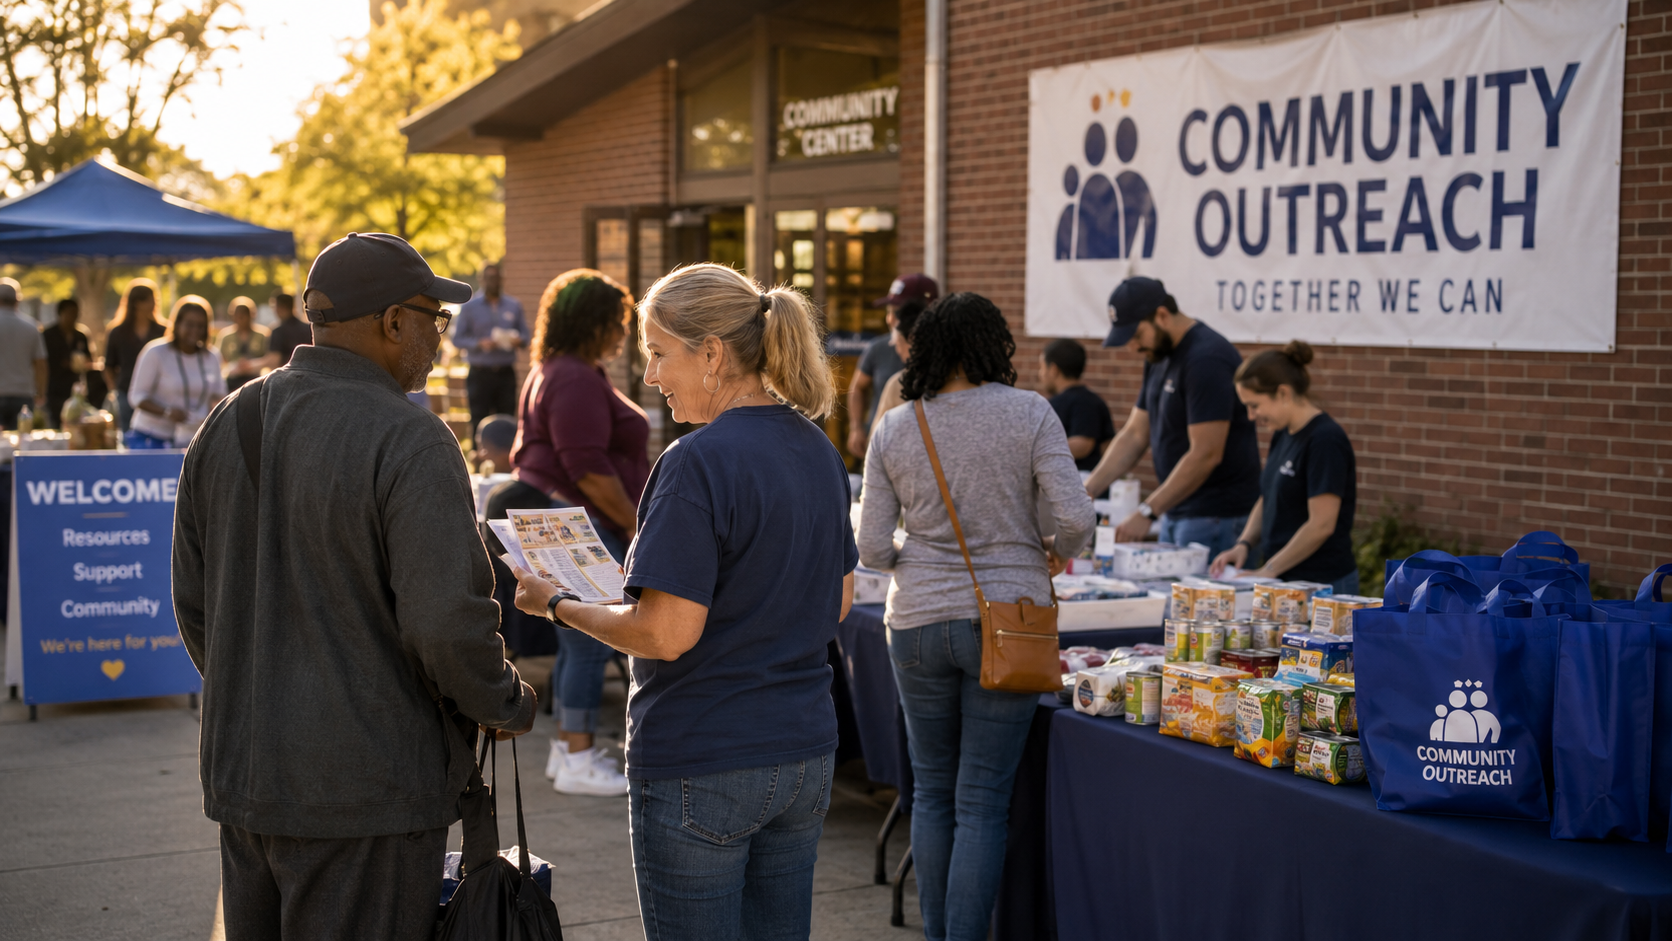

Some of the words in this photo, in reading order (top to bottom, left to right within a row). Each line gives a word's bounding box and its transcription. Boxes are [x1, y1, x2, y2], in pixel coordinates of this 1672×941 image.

[783, 86, 899, 129] COMMUNITY
[1178, 61, 1581, 176] COMMUNITY
[801, 122, 874, 157] CENTER
[1194, 168, 1539, 257] OUTREACH
[1216, 279, 1361, 313] TOGETHER
[1379, 279, 1421, 313] WE
[1439, 278, 1503, 313] CAN
[26, 478, 177, 505] WELCOME
[62, 528, 151, 547] Resources
[73, 562, 144, 584] Support
[61, 597, 160, 618] Community
[40, 639, 84, 654] We're
[87, 636, 122, 651] here
[125, 634, 146, 649] for
[1417, 745, 1516, 766] COMMUNITY
[1422, 764, 1513, 785] OUTREACH
